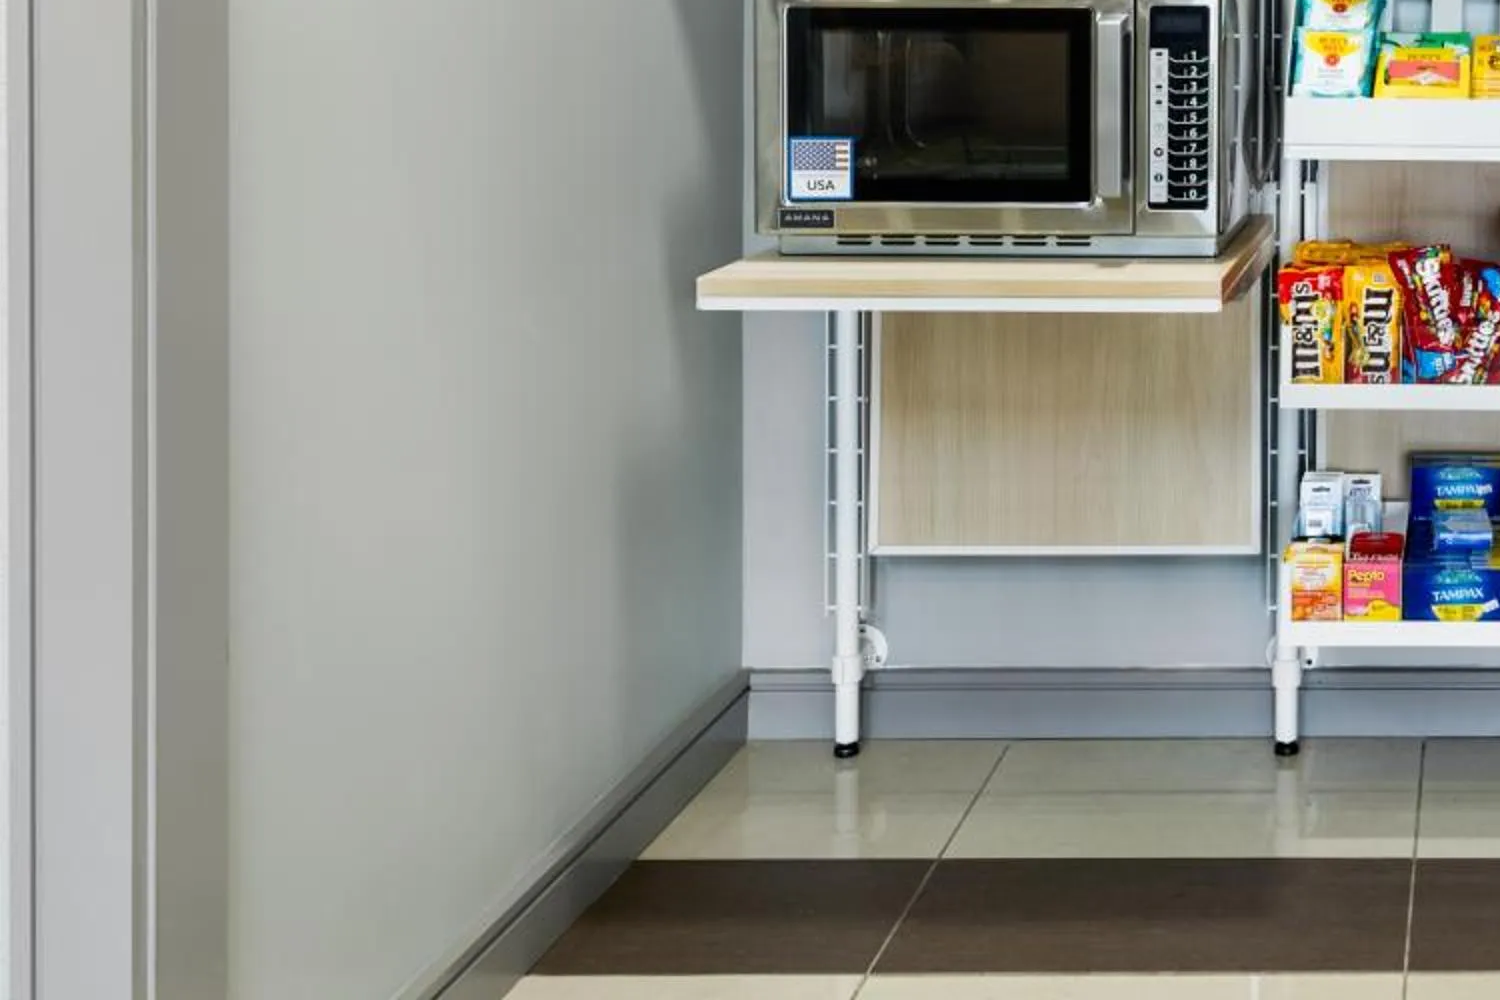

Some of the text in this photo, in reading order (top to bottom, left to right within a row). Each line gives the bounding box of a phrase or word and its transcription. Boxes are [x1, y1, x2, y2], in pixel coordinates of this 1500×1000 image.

[1190, 66, 1198, 75] 2
[1190, 82, 1198, 91] 3
[1190, 97, 1198, 106] 4
[1190, 112, 1198, 122] 5
[1190, 128, 1198, 138] 6
[1190, 144, 1198, 153] 7
[1190, 158, 1198, 168] 8
[1190, 174, 1198, 183] 9
[806, 179, 835, 191] USA
[1190, 189, 1198, 199] 0
[784, 211, 830, 221] AMANA
[1347, 569, 1385, 586] Pepto
[1432, 587, 1485, 603] TAMPAX
